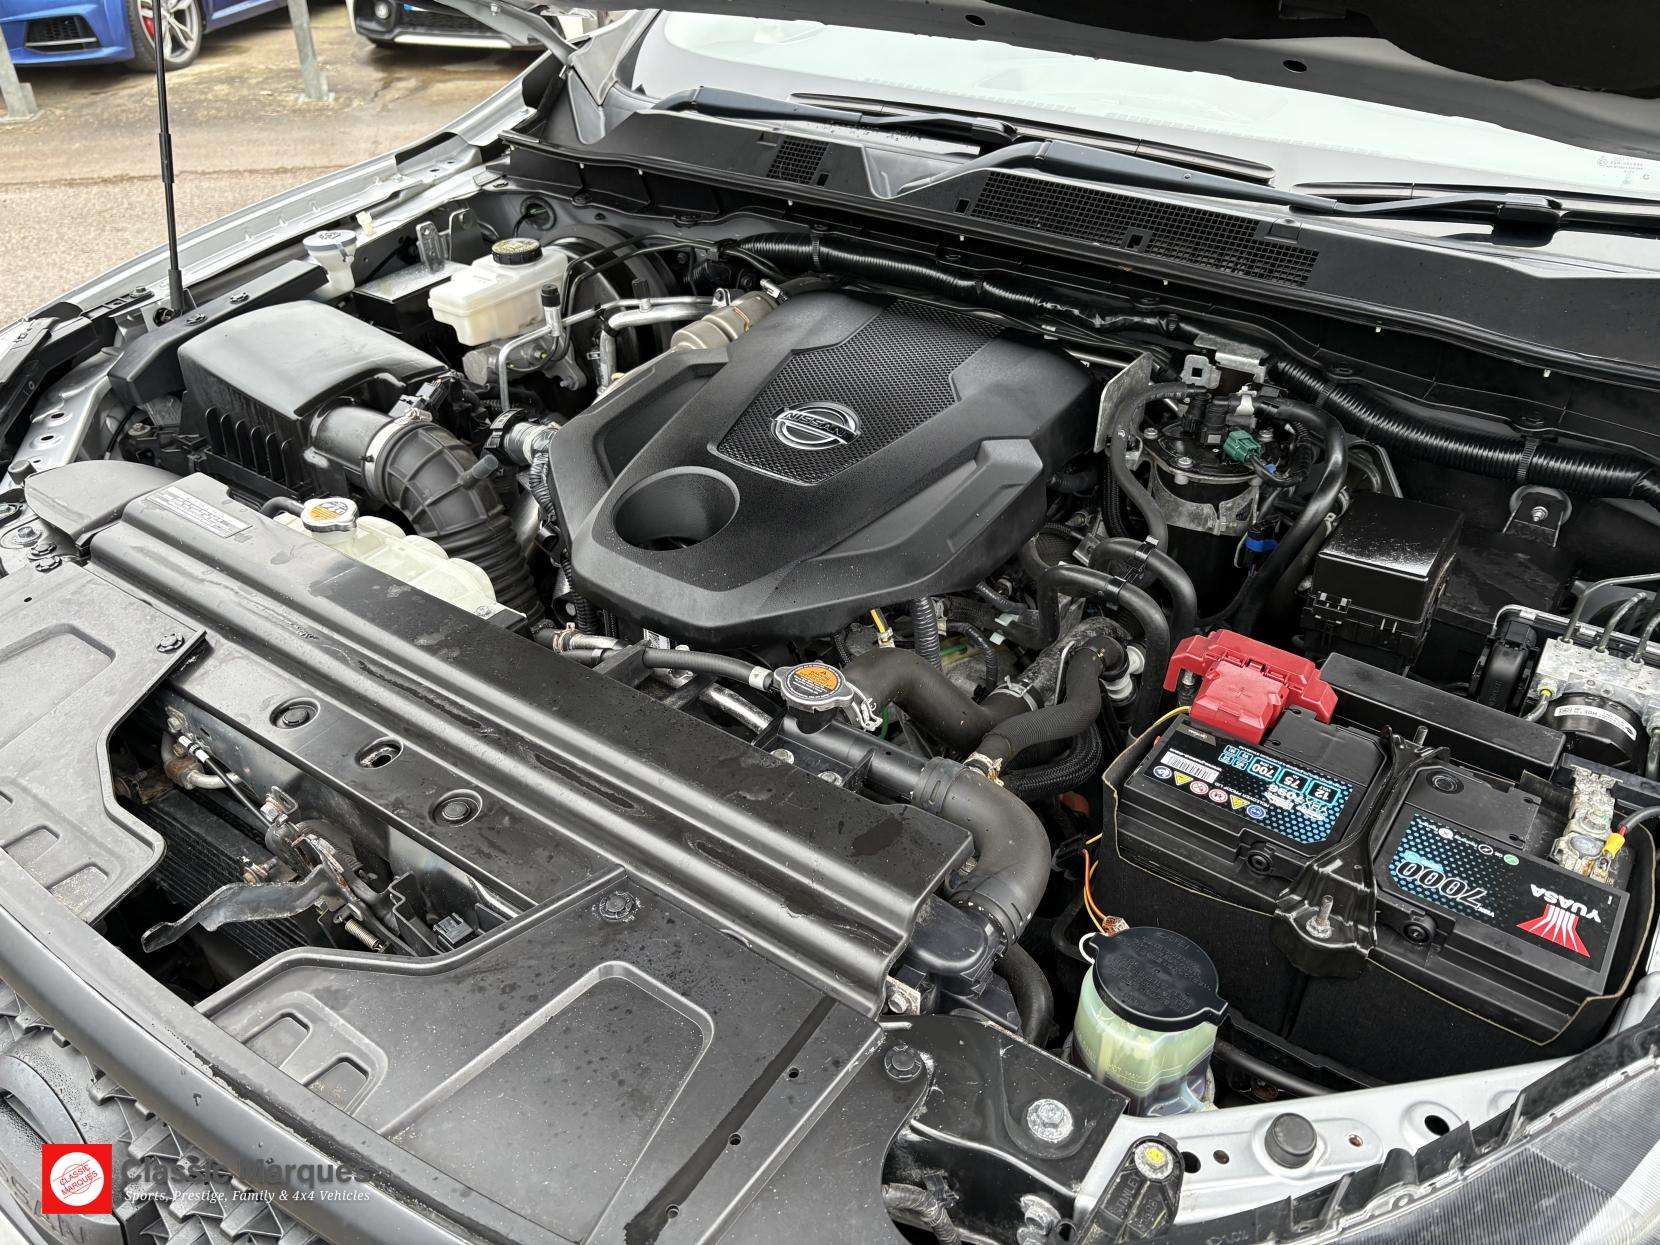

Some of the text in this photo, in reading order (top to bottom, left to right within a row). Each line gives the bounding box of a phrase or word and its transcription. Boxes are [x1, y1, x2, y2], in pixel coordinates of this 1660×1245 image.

[784, 412, 846, 437] NISSAN
[1251, 763, 1275, 778] 700
[1284, 776, 1301, 789] 75
[1314, 788, 1330, 801] 12
[1396, 859, 1487, 909] 7000
[1530, 883, 1602, 923] YUASA
